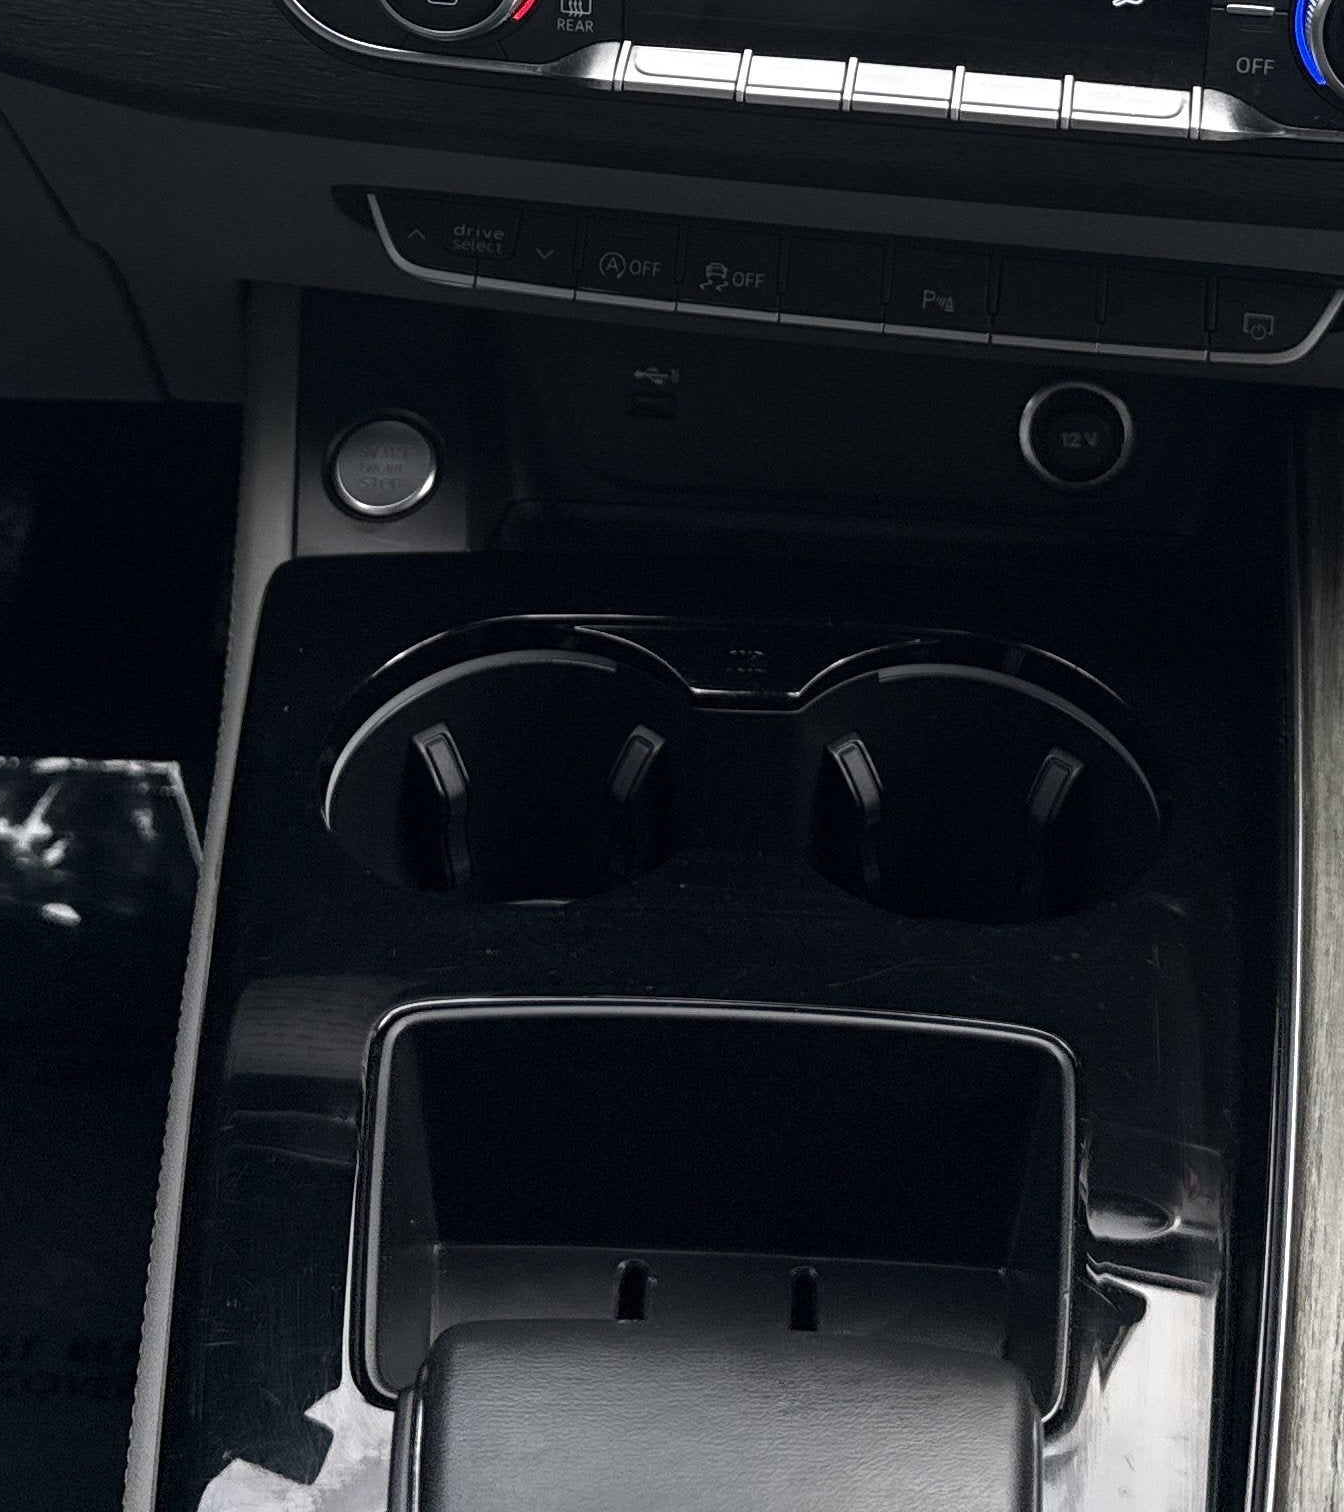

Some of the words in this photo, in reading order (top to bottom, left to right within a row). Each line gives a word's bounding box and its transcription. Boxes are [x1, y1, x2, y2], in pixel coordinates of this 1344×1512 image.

[556, 16, 595, 34] REAR
[1235, 56, 1275, 76] OFF
[453, 223, 506, 240] drive
[628, 258, 663, 277] OFF
[731, 271, 766, 288] OFF
